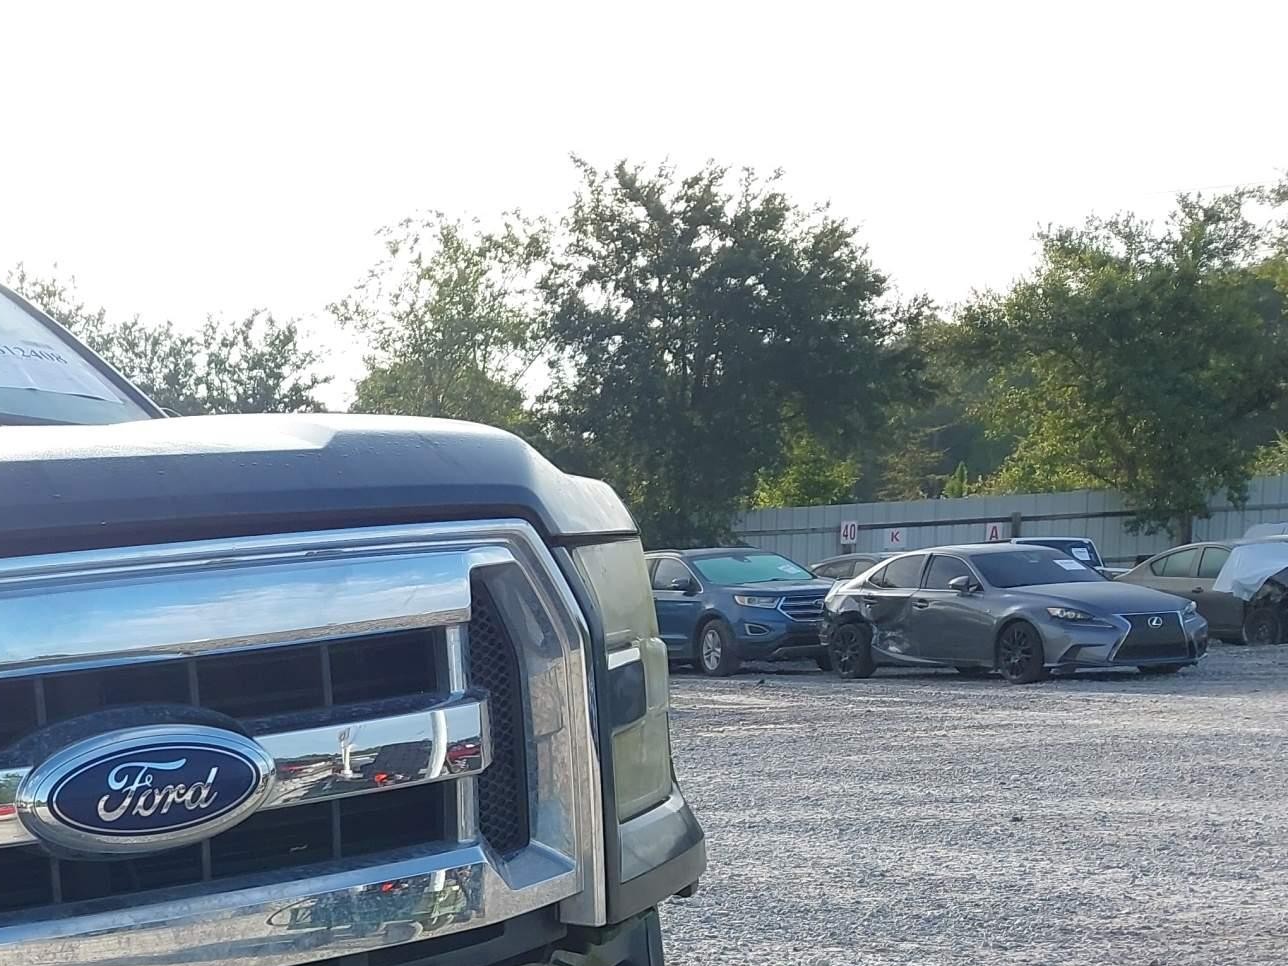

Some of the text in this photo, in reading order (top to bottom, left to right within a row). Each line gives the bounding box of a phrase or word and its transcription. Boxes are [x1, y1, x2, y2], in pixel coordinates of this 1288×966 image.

[842, 523, 856, 541] 40
[890, 531, 900, 542] K
[989, 525, 999, 541] A
[97, 758, 219, 822] Ford
